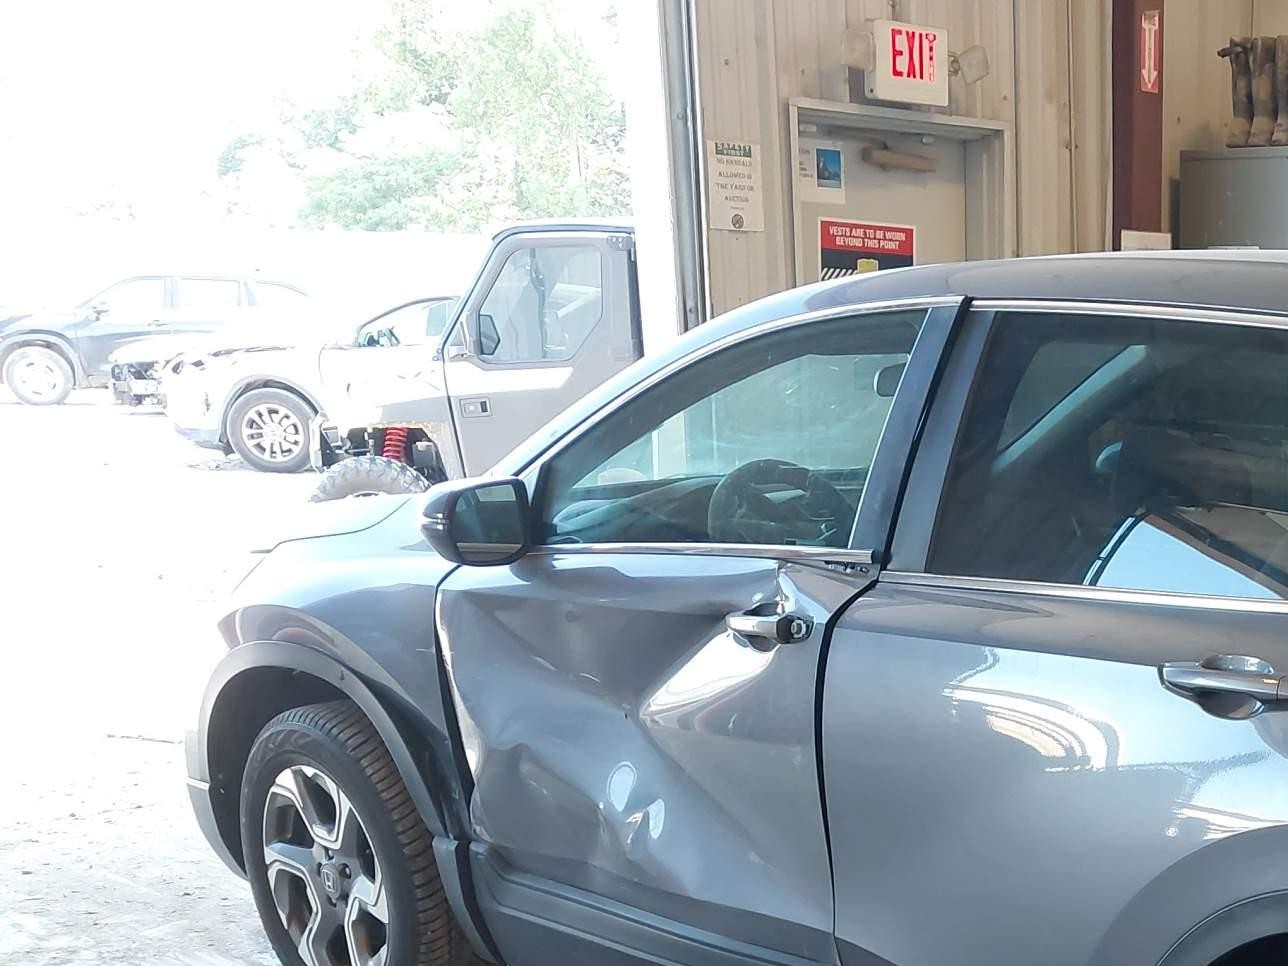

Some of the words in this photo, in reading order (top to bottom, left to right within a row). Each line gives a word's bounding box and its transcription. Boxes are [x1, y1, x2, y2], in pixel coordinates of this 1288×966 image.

[890, 27, 937, 82] EXIT
[829, 225, 851, 236] VESTS
[851, 228, 865, 238] ARE
[865, 229, 875, 239] TO
[875, 230, 885, 240] BE
[885, 231, 906, 241] WORN
[835, 236, 863, 247] BEYOND
[864, 238, 879, 248] THIS
[880, 240, 900, 250] POINT
